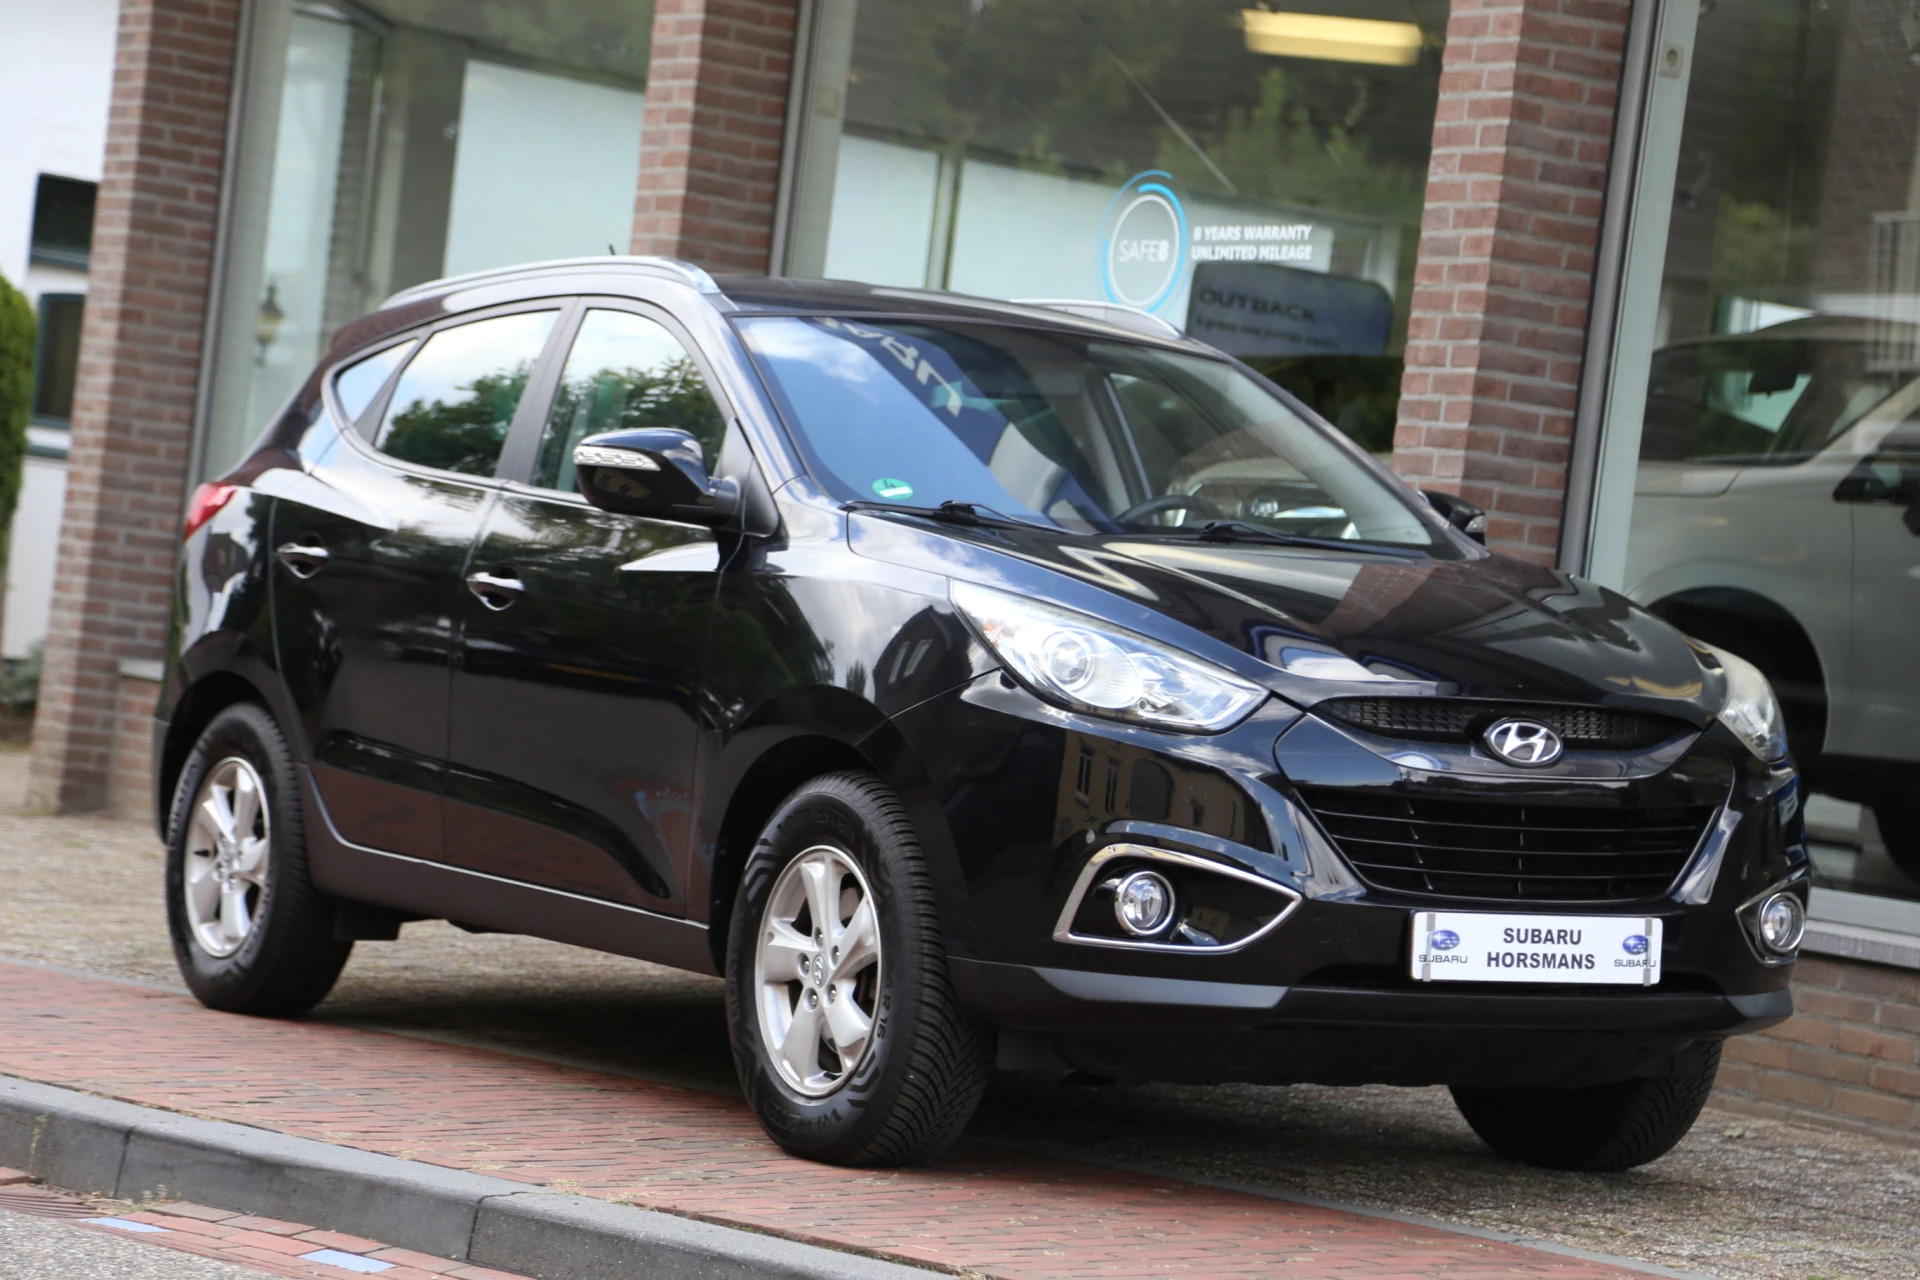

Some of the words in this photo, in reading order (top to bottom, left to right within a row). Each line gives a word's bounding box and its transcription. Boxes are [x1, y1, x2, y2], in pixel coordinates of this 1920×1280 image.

[1193, 226, 1202, 241] 8
[1204, 226, 1241, 241] YEARS
[1244, 225, 1312, 241] WARRANTY
[1118, 239, 1169, 262] SAFE8
[1191, 245, 1257, 261] UNLIMITED
[1258, 245, 1312, 261] MILEAGE
[1199, 287, 1316, 322] OUTBACK
[1503, 927, 1581, 945] SUBARU
[1418, 954, 1468, 964] SUBARU
[1487, 952, 1595, 970] HORSMANS
[1614, 959, 1656, 968] SUBARU
